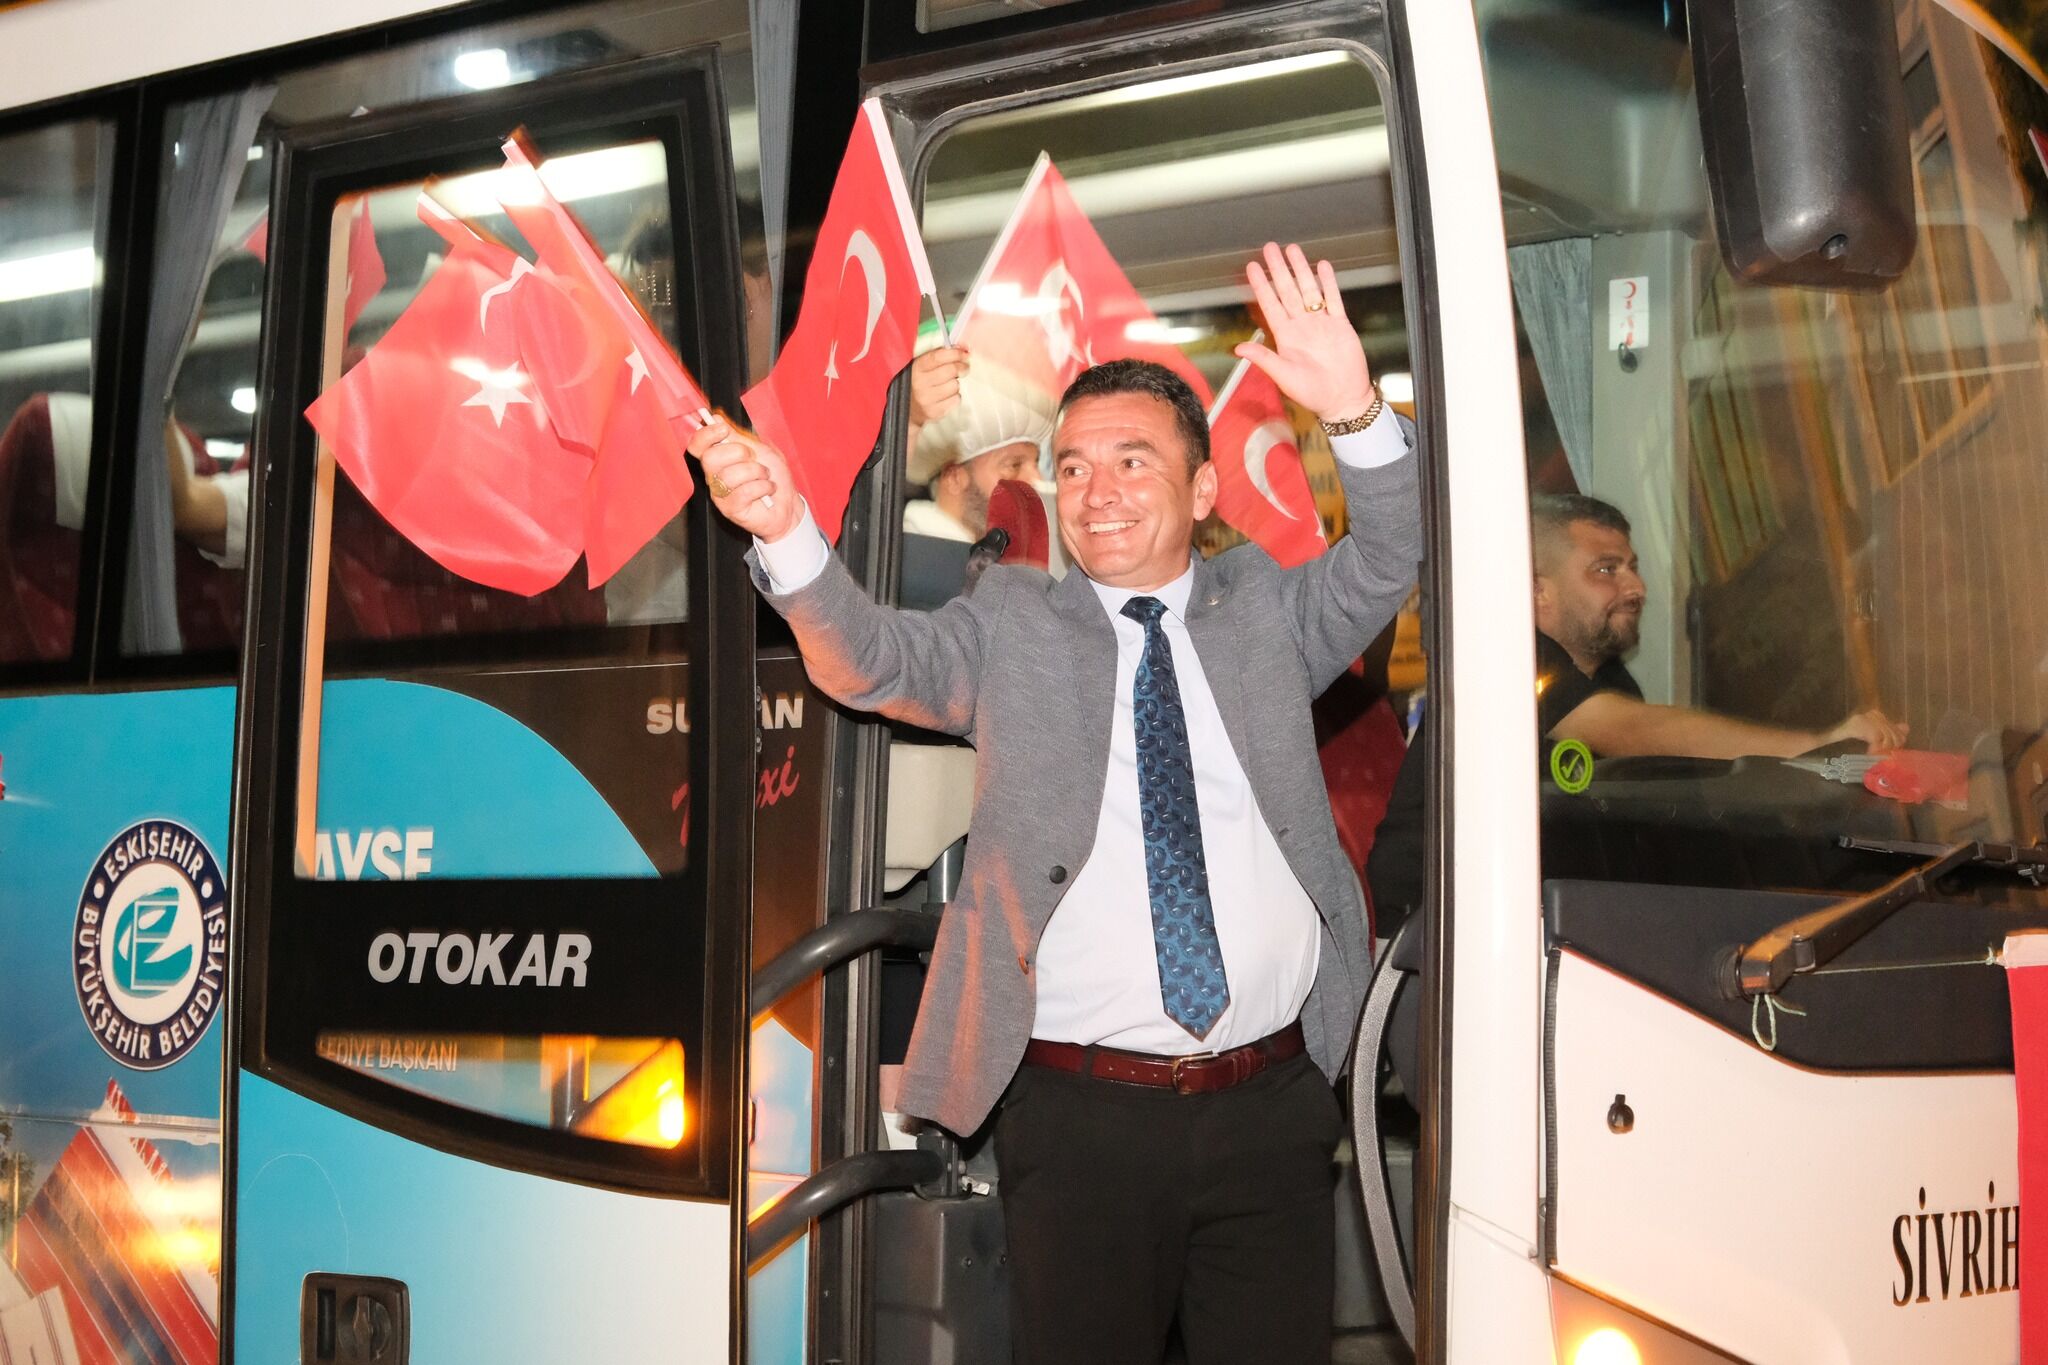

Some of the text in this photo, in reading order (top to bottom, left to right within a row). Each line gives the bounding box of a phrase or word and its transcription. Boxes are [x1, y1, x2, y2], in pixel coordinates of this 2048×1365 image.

[104, 828, 204, 882] ESKİŞEHİR
[78, 906, 226, 1059] BÜYÜKŞEHİR BELEDİYESİ
[368, 932, 592, 987] OTOKAR
[379, 1038, 457, 1072] BAŞKANI
